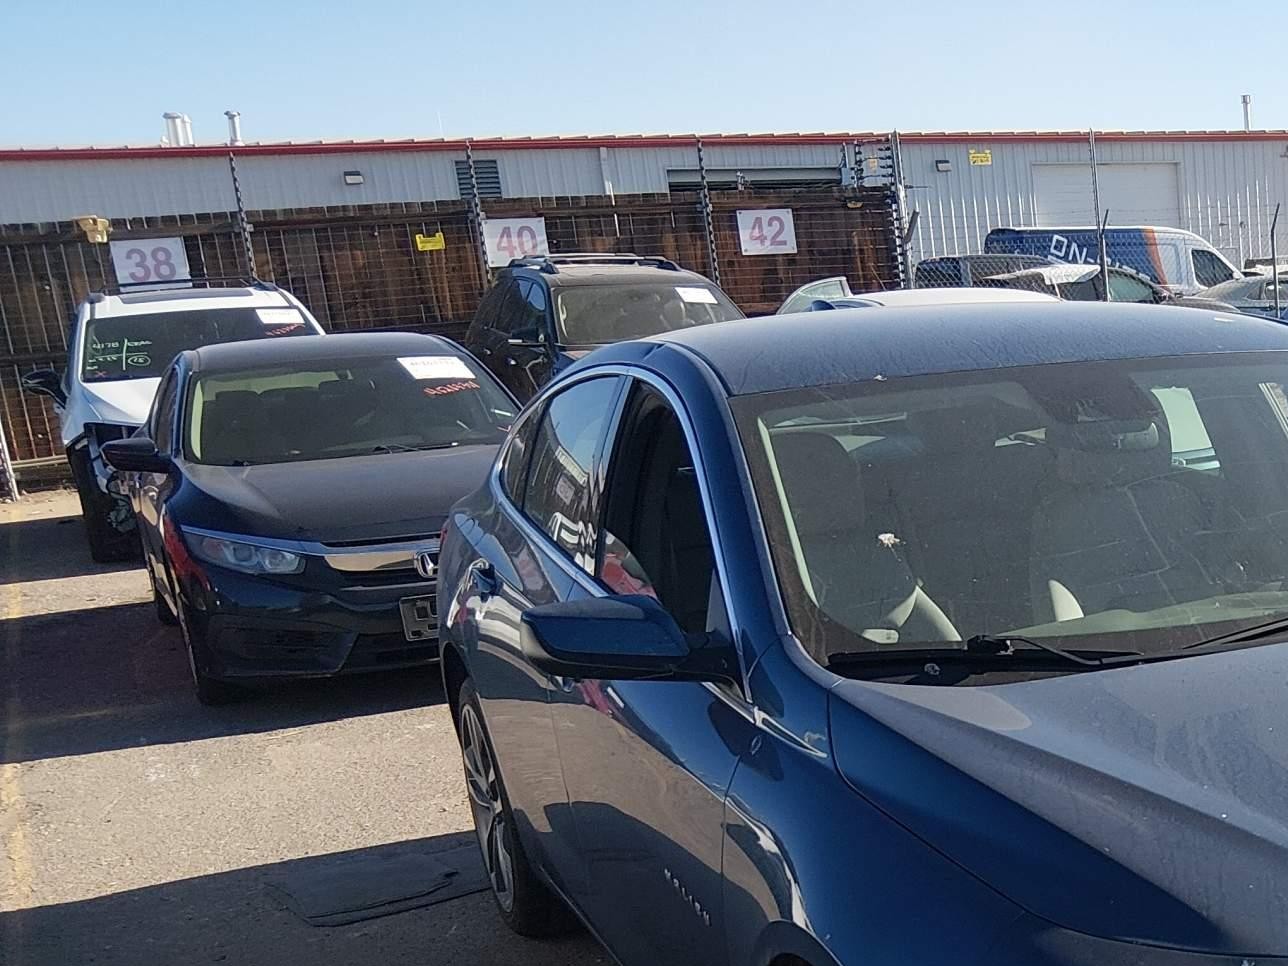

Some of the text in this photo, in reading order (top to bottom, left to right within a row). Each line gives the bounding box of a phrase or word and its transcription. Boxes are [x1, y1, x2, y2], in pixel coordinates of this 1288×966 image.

[496, 225, 538, 258] 40
[750, 215, 788, 247] 42
[125, 246, 177, 282] 38
